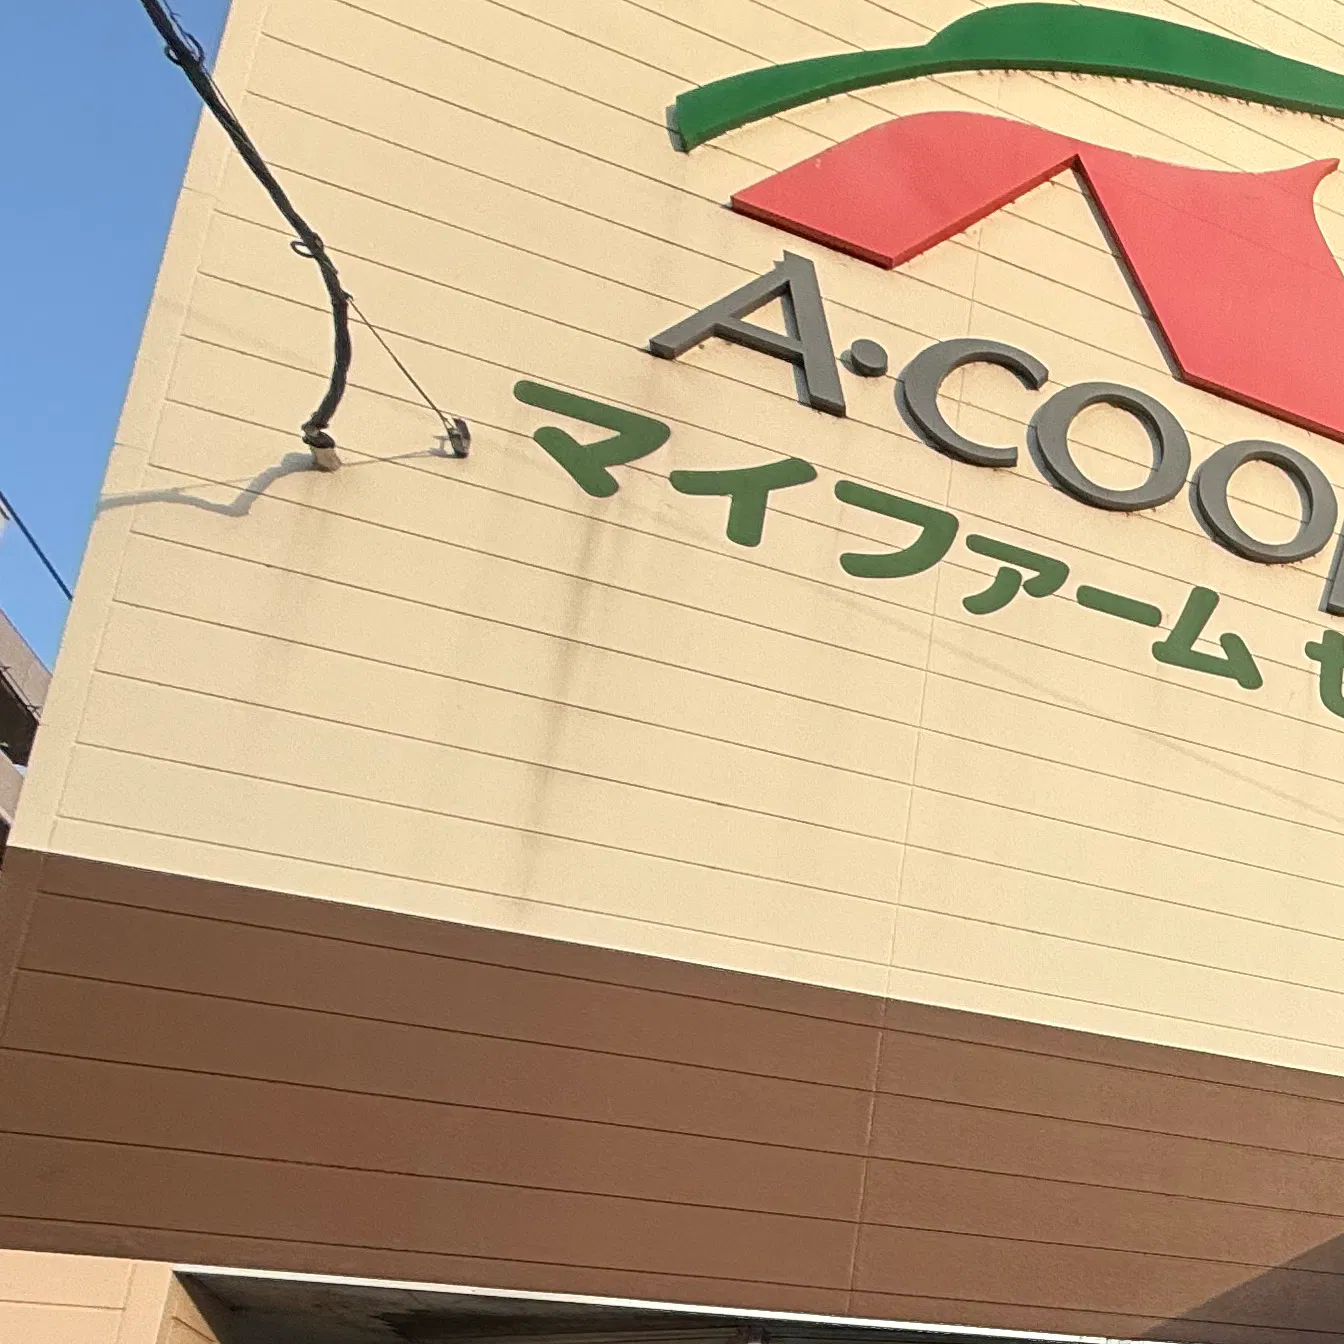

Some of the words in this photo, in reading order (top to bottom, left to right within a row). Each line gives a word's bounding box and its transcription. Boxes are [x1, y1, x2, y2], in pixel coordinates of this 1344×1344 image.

[513, 379, 1263, 690] マイファーム
